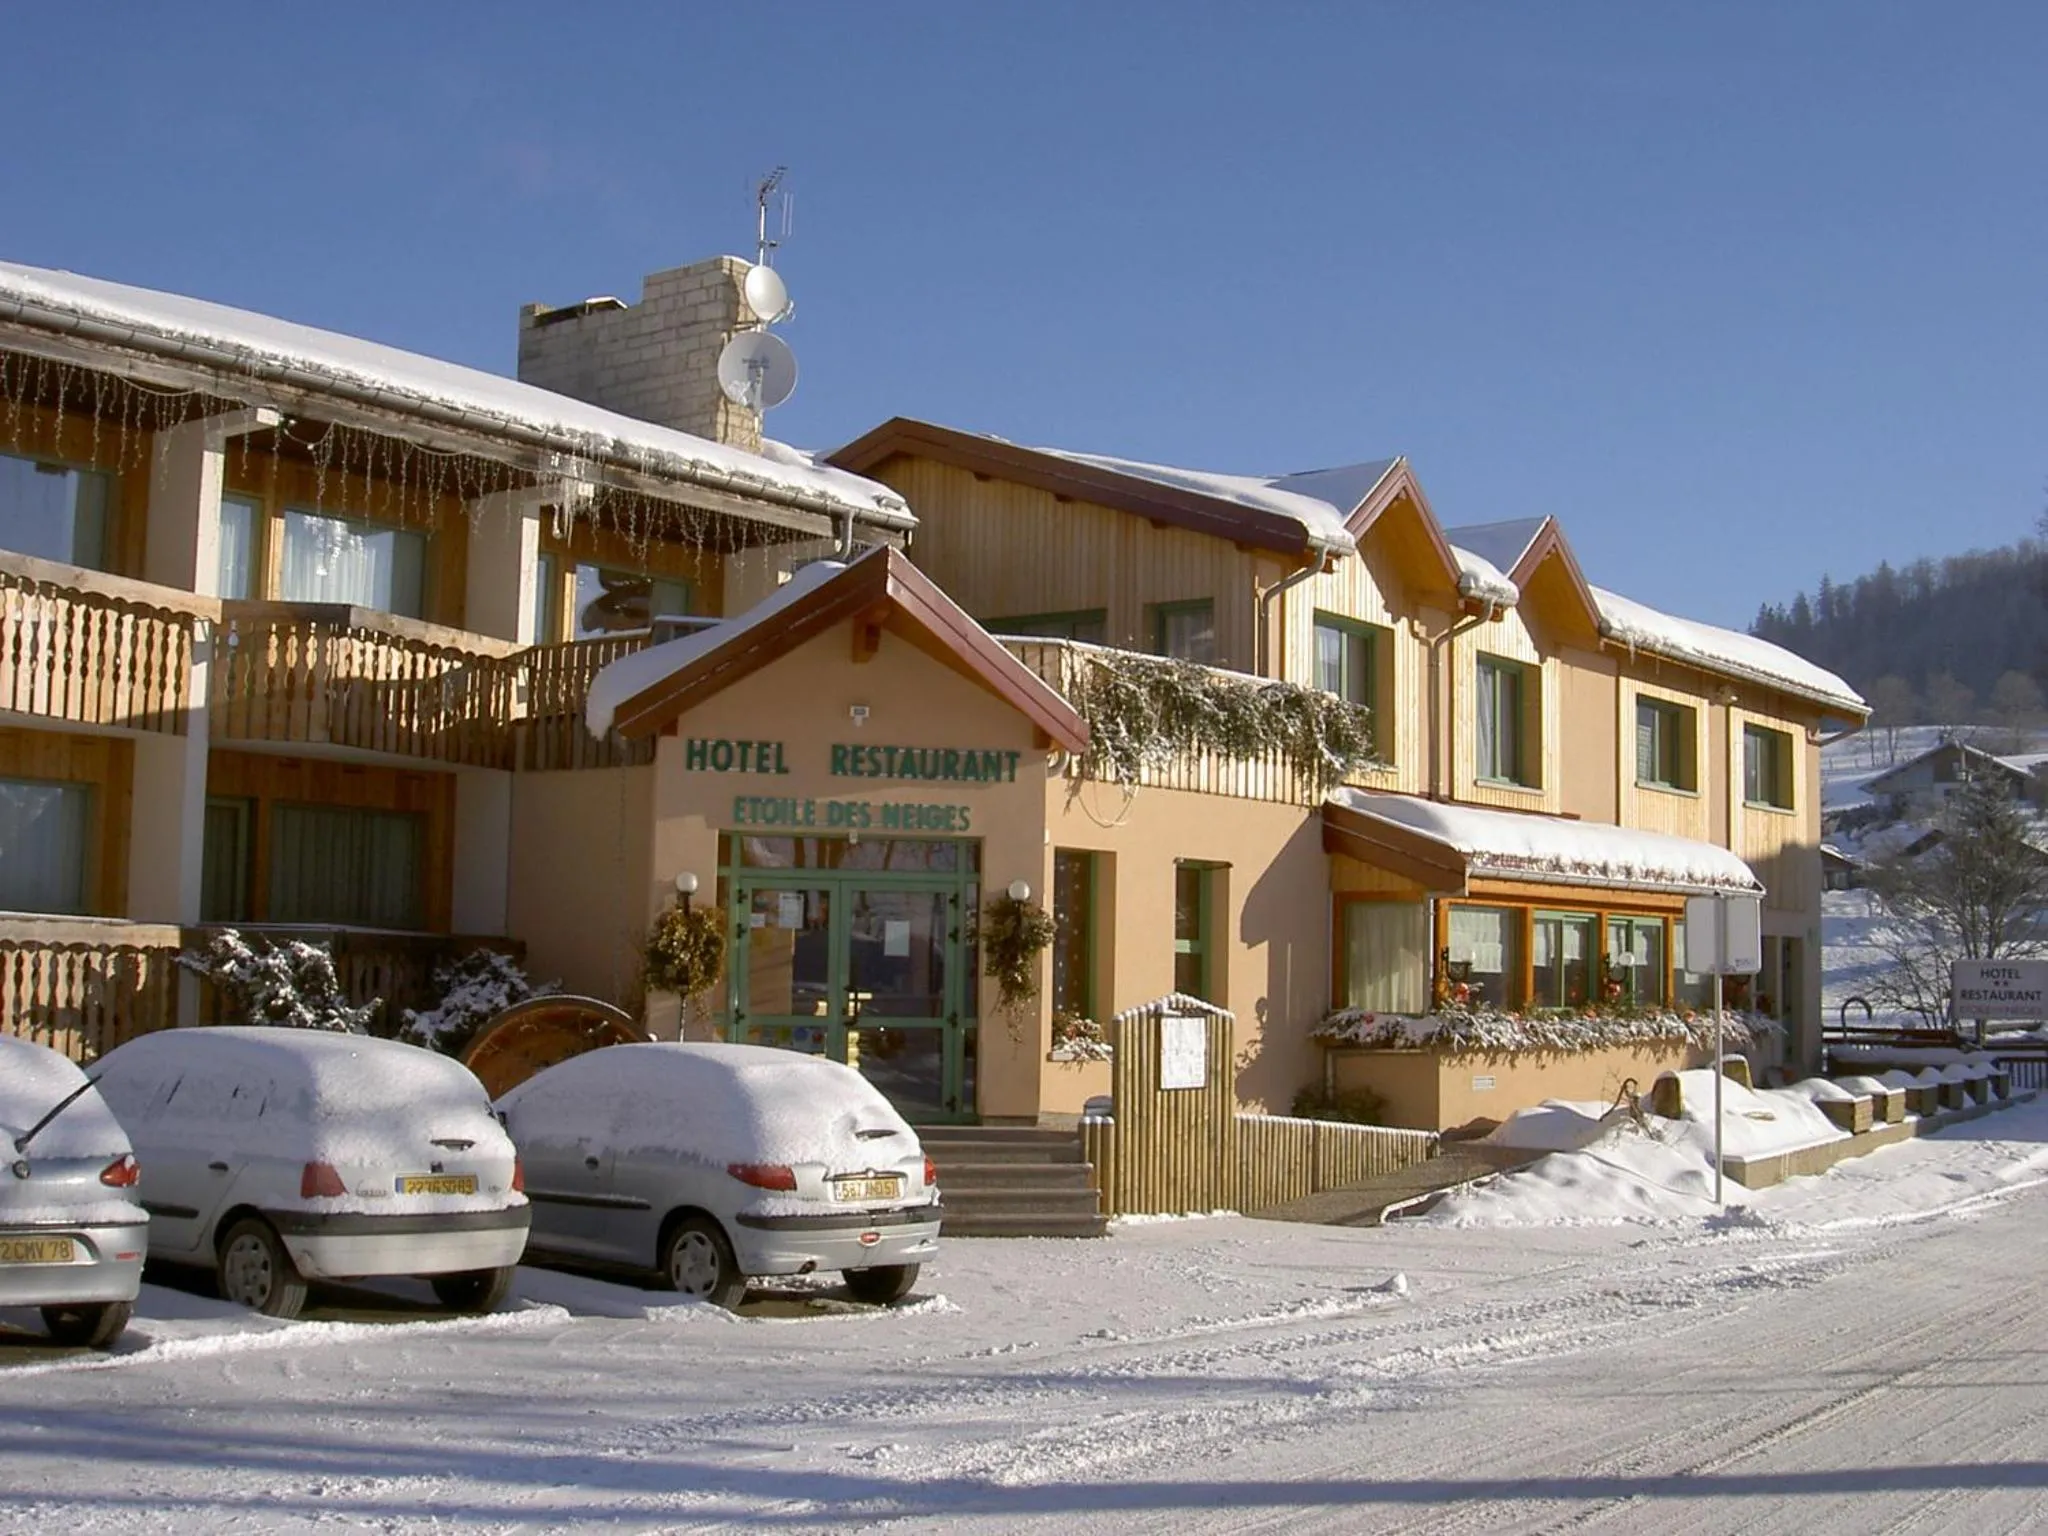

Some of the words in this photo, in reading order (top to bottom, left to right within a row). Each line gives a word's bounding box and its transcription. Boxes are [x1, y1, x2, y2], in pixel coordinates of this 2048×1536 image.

[686, 738, 789, 775] HOTEL
[830, 743, 1021, 783] RESTAURANT
[733, 795, 815, 827] ETOILE
[827, 799, 871, 829] DES
[882, 801, 971, 832] NEIGES
[1980, 967, 2022, 980] HOTEL
[1960, 989, 2043, 1001] RESTAURANT
[48, 1240, 69, 1258] 78
